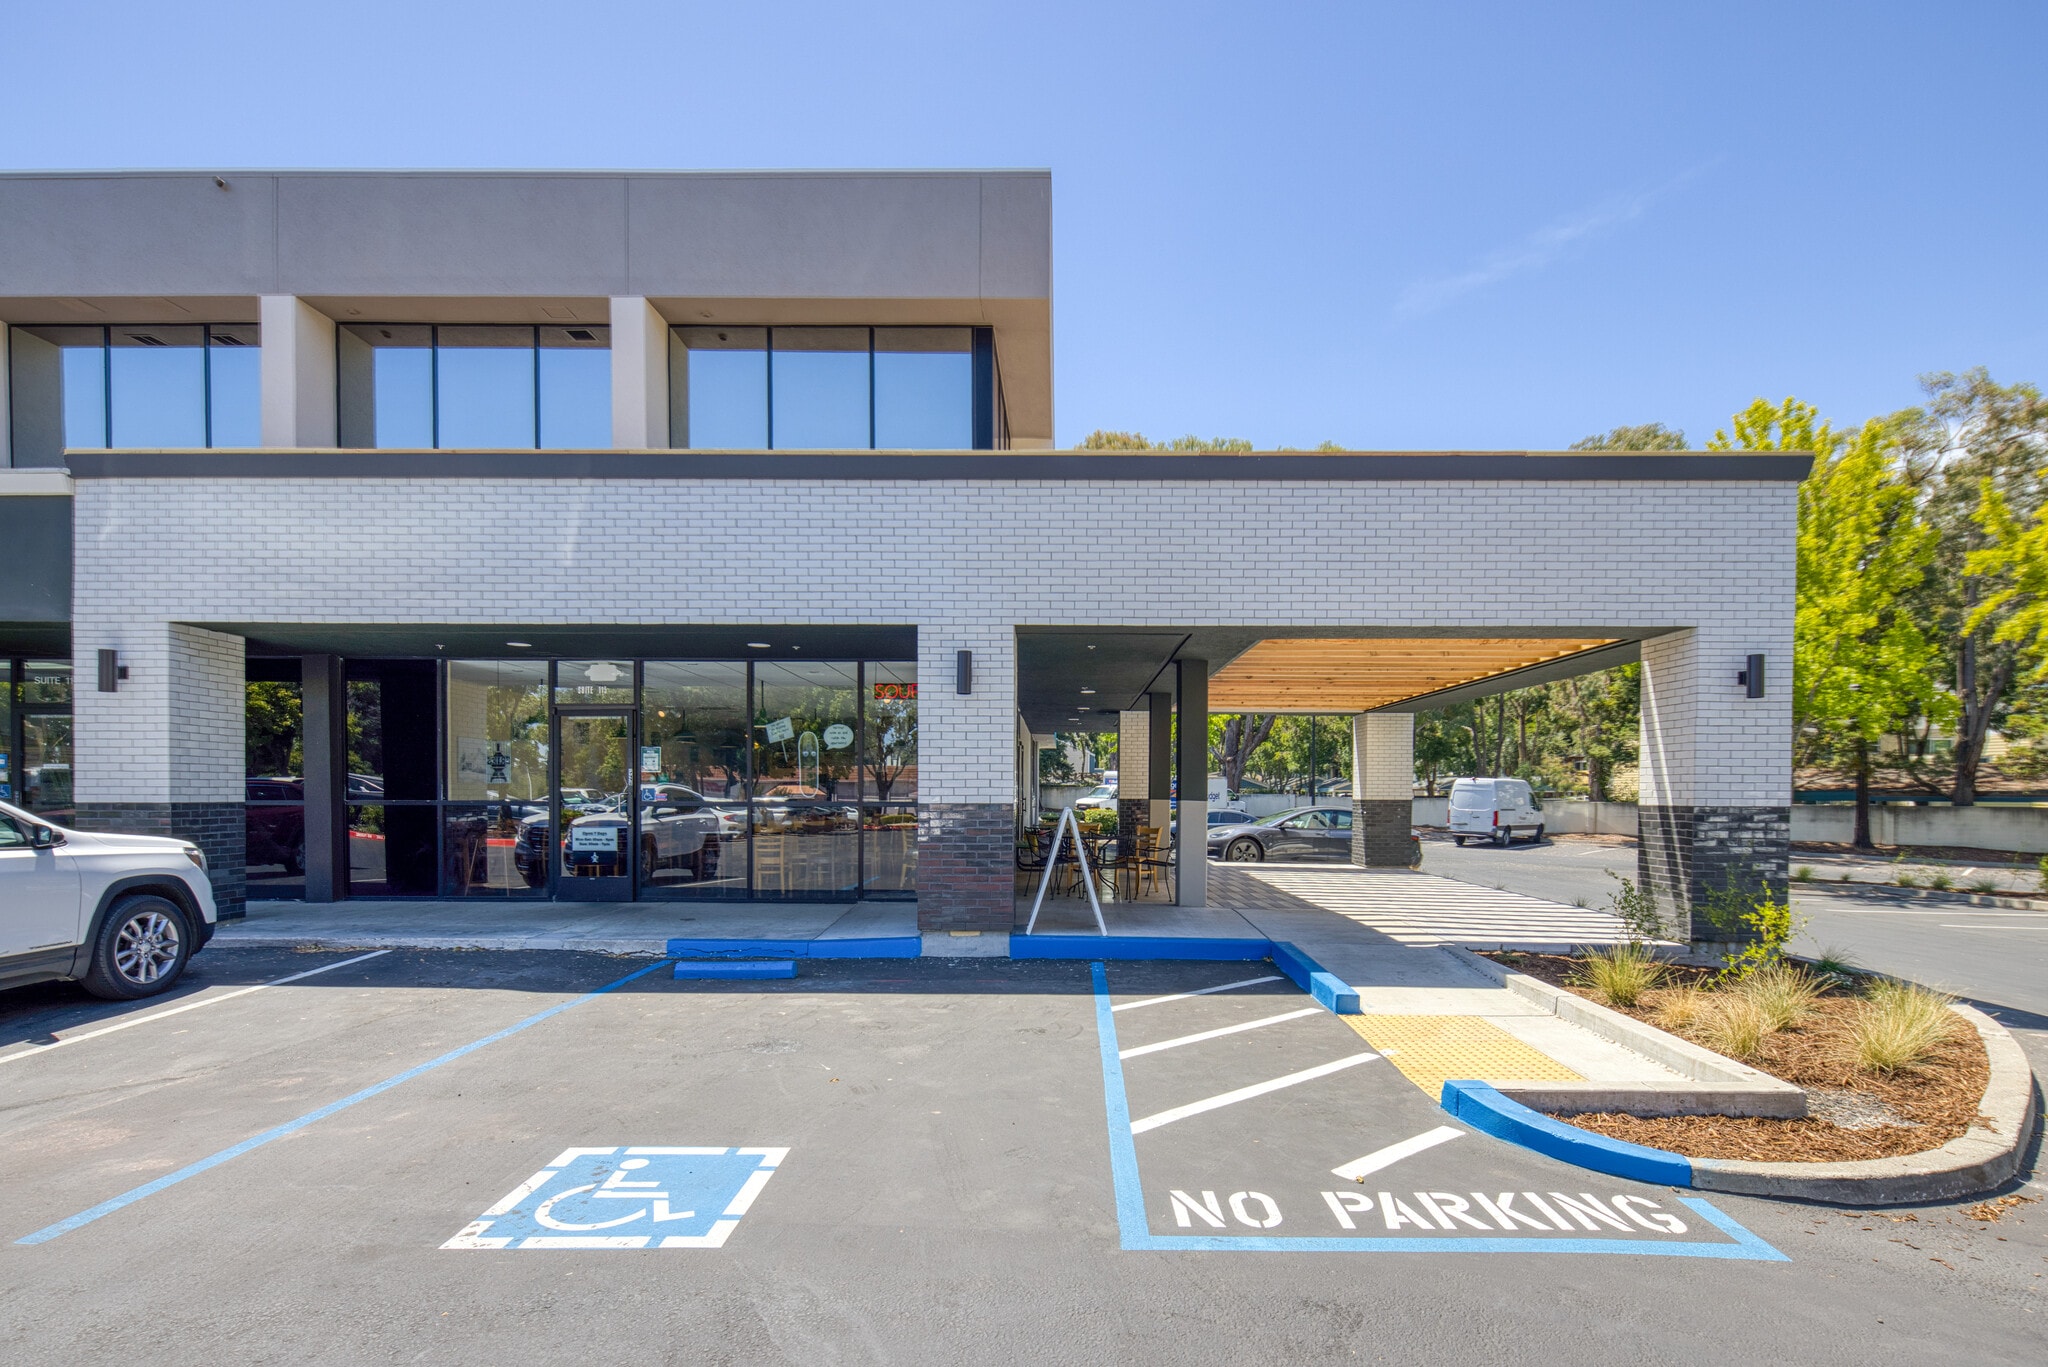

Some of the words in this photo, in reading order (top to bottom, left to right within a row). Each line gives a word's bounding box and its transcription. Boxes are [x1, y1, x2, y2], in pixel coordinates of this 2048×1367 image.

[34, 676, 61, 685] SUITE
[577, 685, 593, 695] SUITE
[1169, 1189, 1283, 1229] NO
[1320, 1191, 1689, 1235] PARKING
